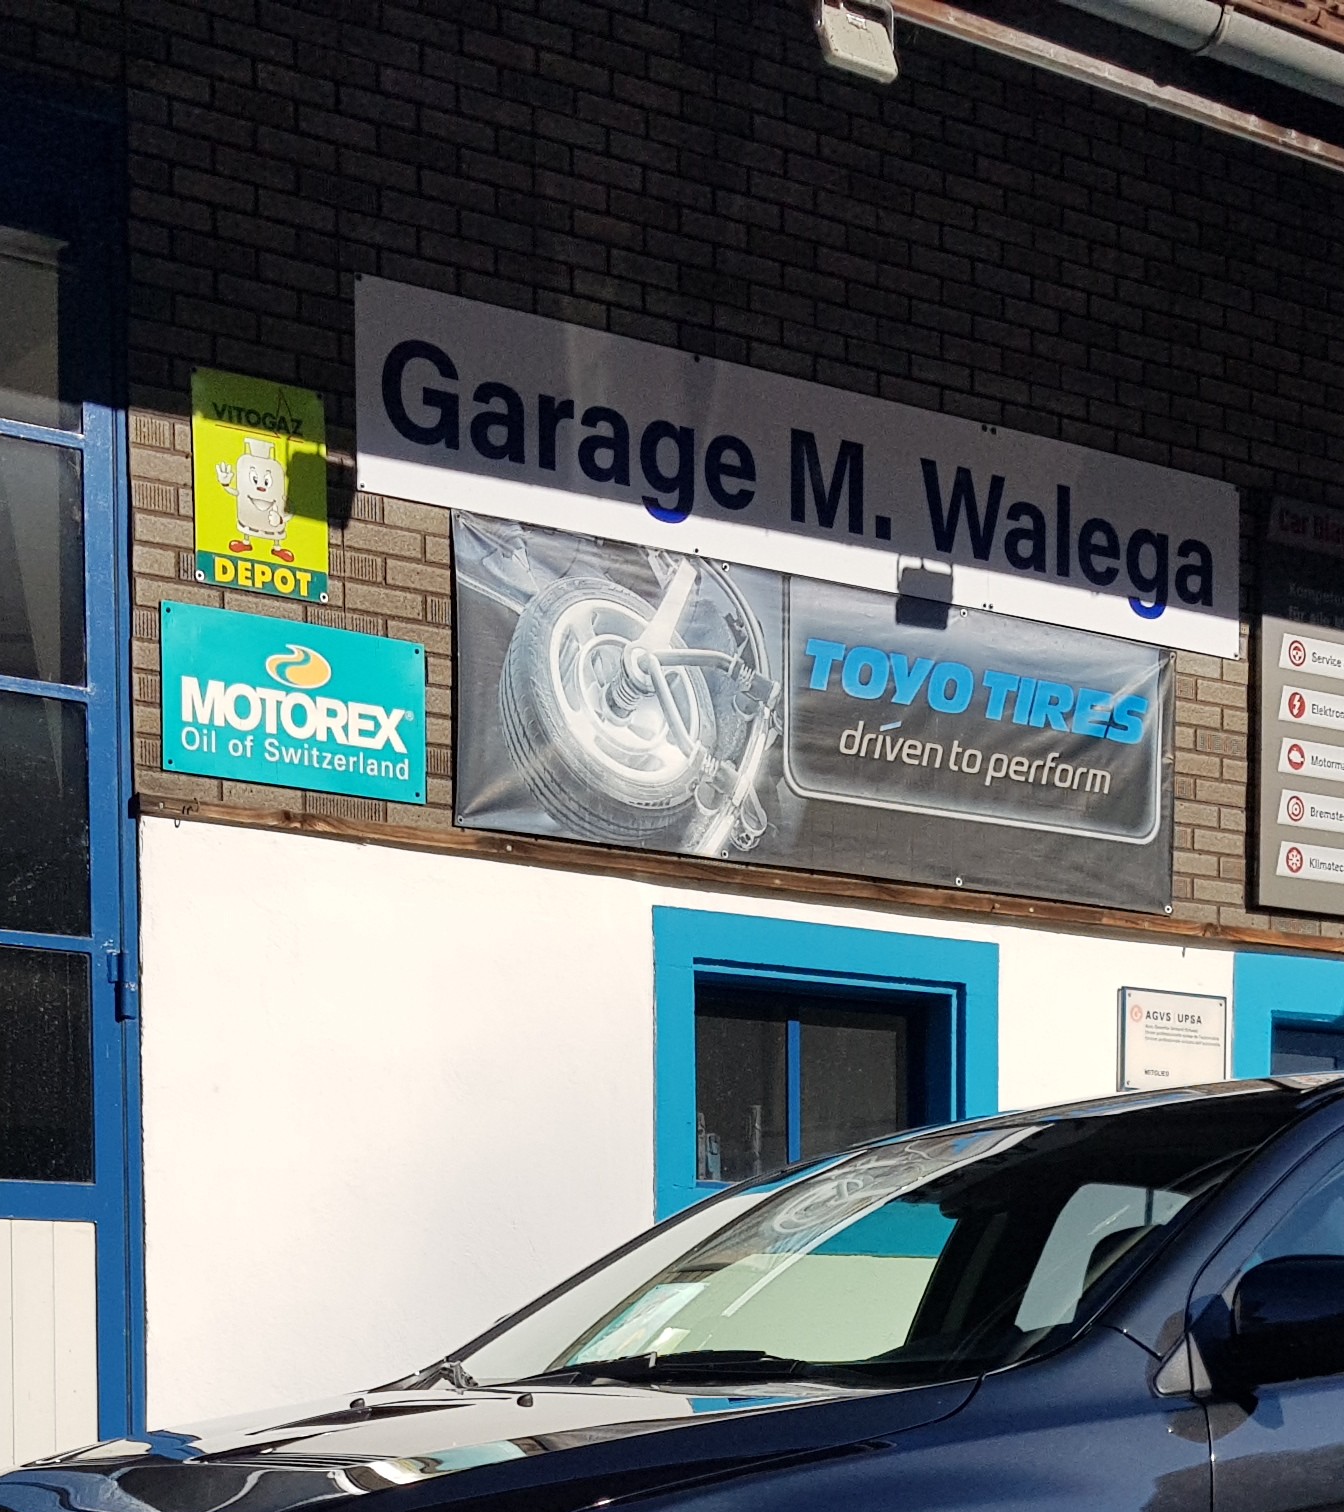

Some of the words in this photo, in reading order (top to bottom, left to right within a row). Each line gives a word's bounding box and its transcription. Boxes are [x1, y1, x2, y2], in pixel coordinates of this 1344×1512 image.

[212, 402, 303, 436] VITOGAZ
[381, 339, 755, 523] Garage
[790, 428, 891, 541] M.
[920, 457, 1213, 619] Walega
[215, 557, 312, 597] DEPOT
[1311, 652, 1342, 668] Service
[181, 675, 407, 754] MOTOREX
[805, 638, 974, 713] TOYO
[981, 669, 1148, 745] TIRES
[181, 727, 216, 753] Oil
[228, 736, 253, 757] of
[264, 738, 409, 780] Switzerland
[840, 720, 943, 768] driven
[949, 737, 981, 773] to
[986, 745, 1111, 794] perform
[1145, 1010, 1171, 1022] AGVS
[1177, 1013, 1202, 1024] UPSA
